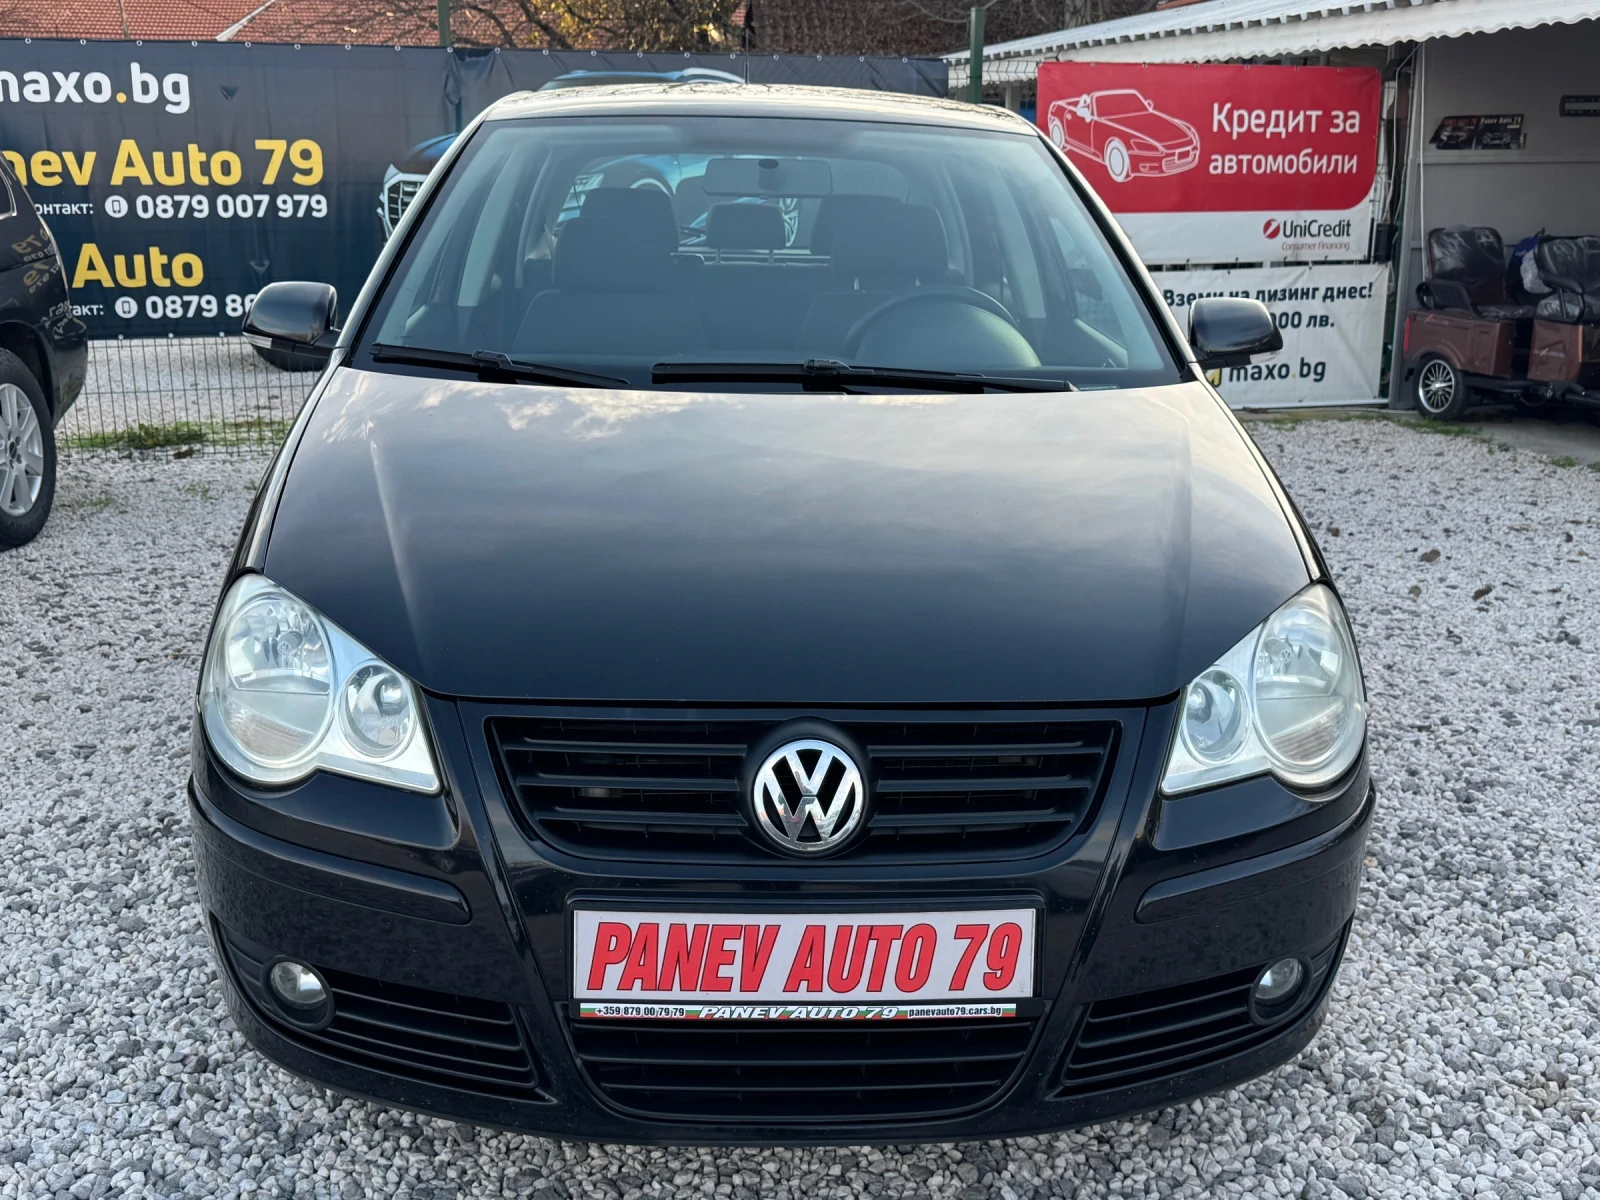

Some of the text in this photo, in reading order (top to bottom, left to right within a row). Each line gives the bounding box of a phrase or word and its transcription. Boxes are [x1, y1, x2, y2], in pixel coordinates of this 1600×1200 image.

[1212, 102, 1361, 140] Кредит за
[110, 139, 242, 186] Auto
[254, 139, 324, 186] 79
[1209, 148, 1358, 175] автомобили
[135, 193, 328, 219] 0879 007 979
[1282, 219, 1352, 239] UniCredit
[1281, 241, 1350, 252] Consumer Financing
[72, 243, 204, 289] Auto
[1255, 286, 1319, 304] лизинг
[1322, 281, 1373, 304] днес!
[69, 304, 104, 316] акт:
[145, 294, 218, 319] 0879
[1306, 314, 1335, 329] лв.
[1229, 357, 1327, 383] maxo.bg
[587, 922, 1023, 994] PANEV AUTO 79
[596, 1006, 1003, 1019] +359 879 00 79 79 PANEV AUTO 79 panevauto79.cars.bg
